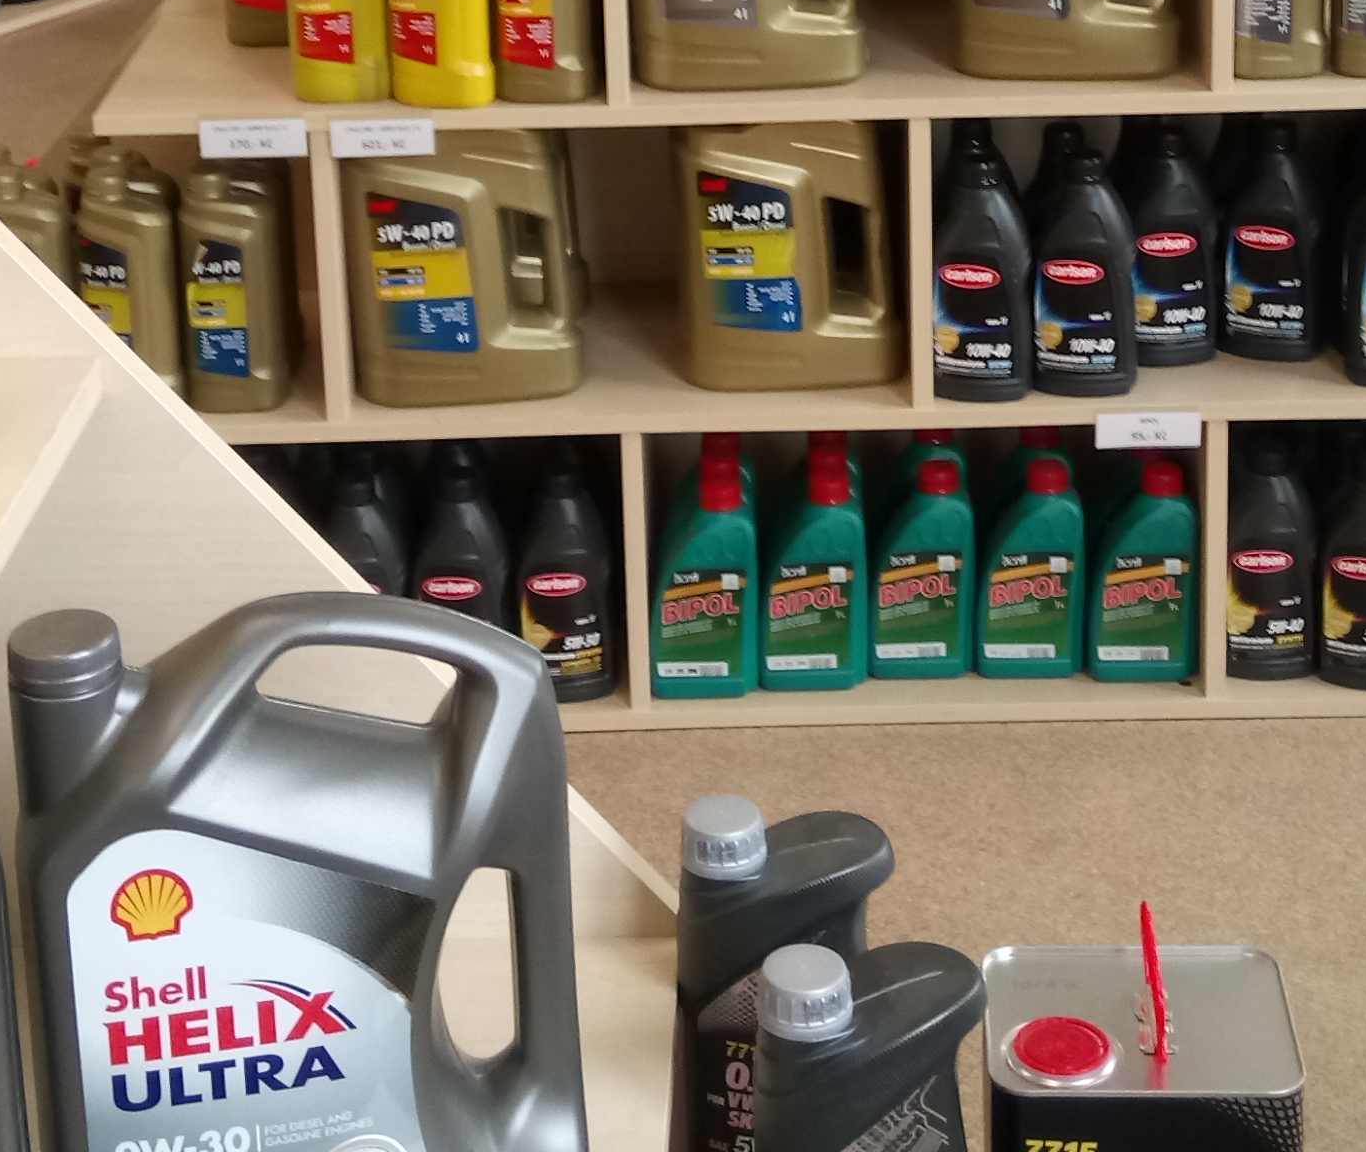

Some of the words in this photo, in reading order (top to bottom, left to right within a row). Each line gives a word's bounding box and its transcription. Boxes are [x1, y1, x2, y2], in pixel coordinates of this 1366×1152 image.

[769, 584, 848, 620] BIPOL
[878, 572, 956, 608] BIPOL
[989, 574, 1068, 608] BIPOL
[1102, 576, 1182, 609] BIPOL
[661, 592, 740, 626] BIPOL
[104, 965, 208, 1013] Shell
[103, 990, 354, 1066] HELIX
[111, 1045, 347, 1113] ULTRA
[264, 1123, 288, 1137] FOR
[290, 1117, 326, 1133] DIESEL
[326, 1110, 353, 1126] AND
[265, 1129, 323, 1148] GASOLINE
[324, 1115, 374, 1137] ENGINES
